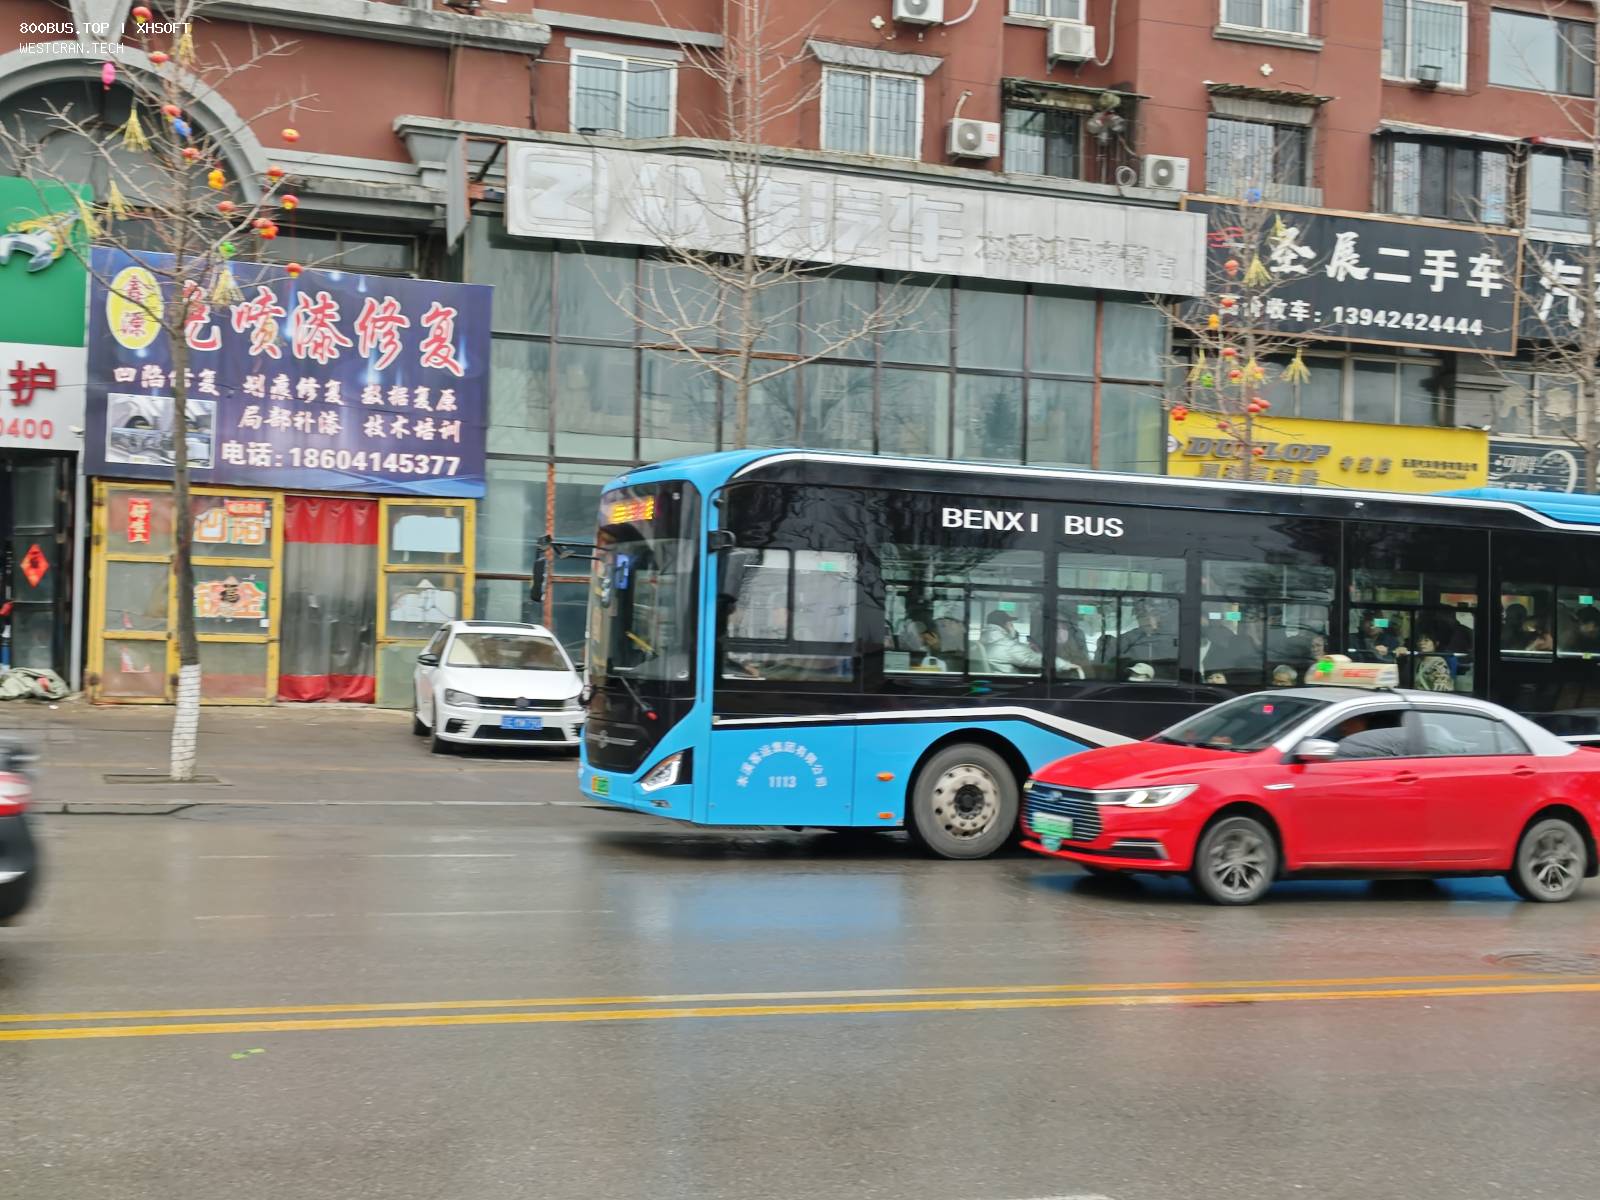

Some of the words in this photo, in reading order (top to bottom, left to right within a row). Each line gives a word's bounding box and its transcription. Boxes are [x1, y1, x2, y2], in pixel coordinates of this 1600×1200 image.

[1268, 226, 1503, 298] 圣展二手车
[8, 360, 57, 407] 护
[238, 405, 344, 436] 局部补漆
[363, 414, 462, 444] 技术培训
[1184, 437, 1332, 464] DULOP
[1064, 515, 1124, 538] BUS
